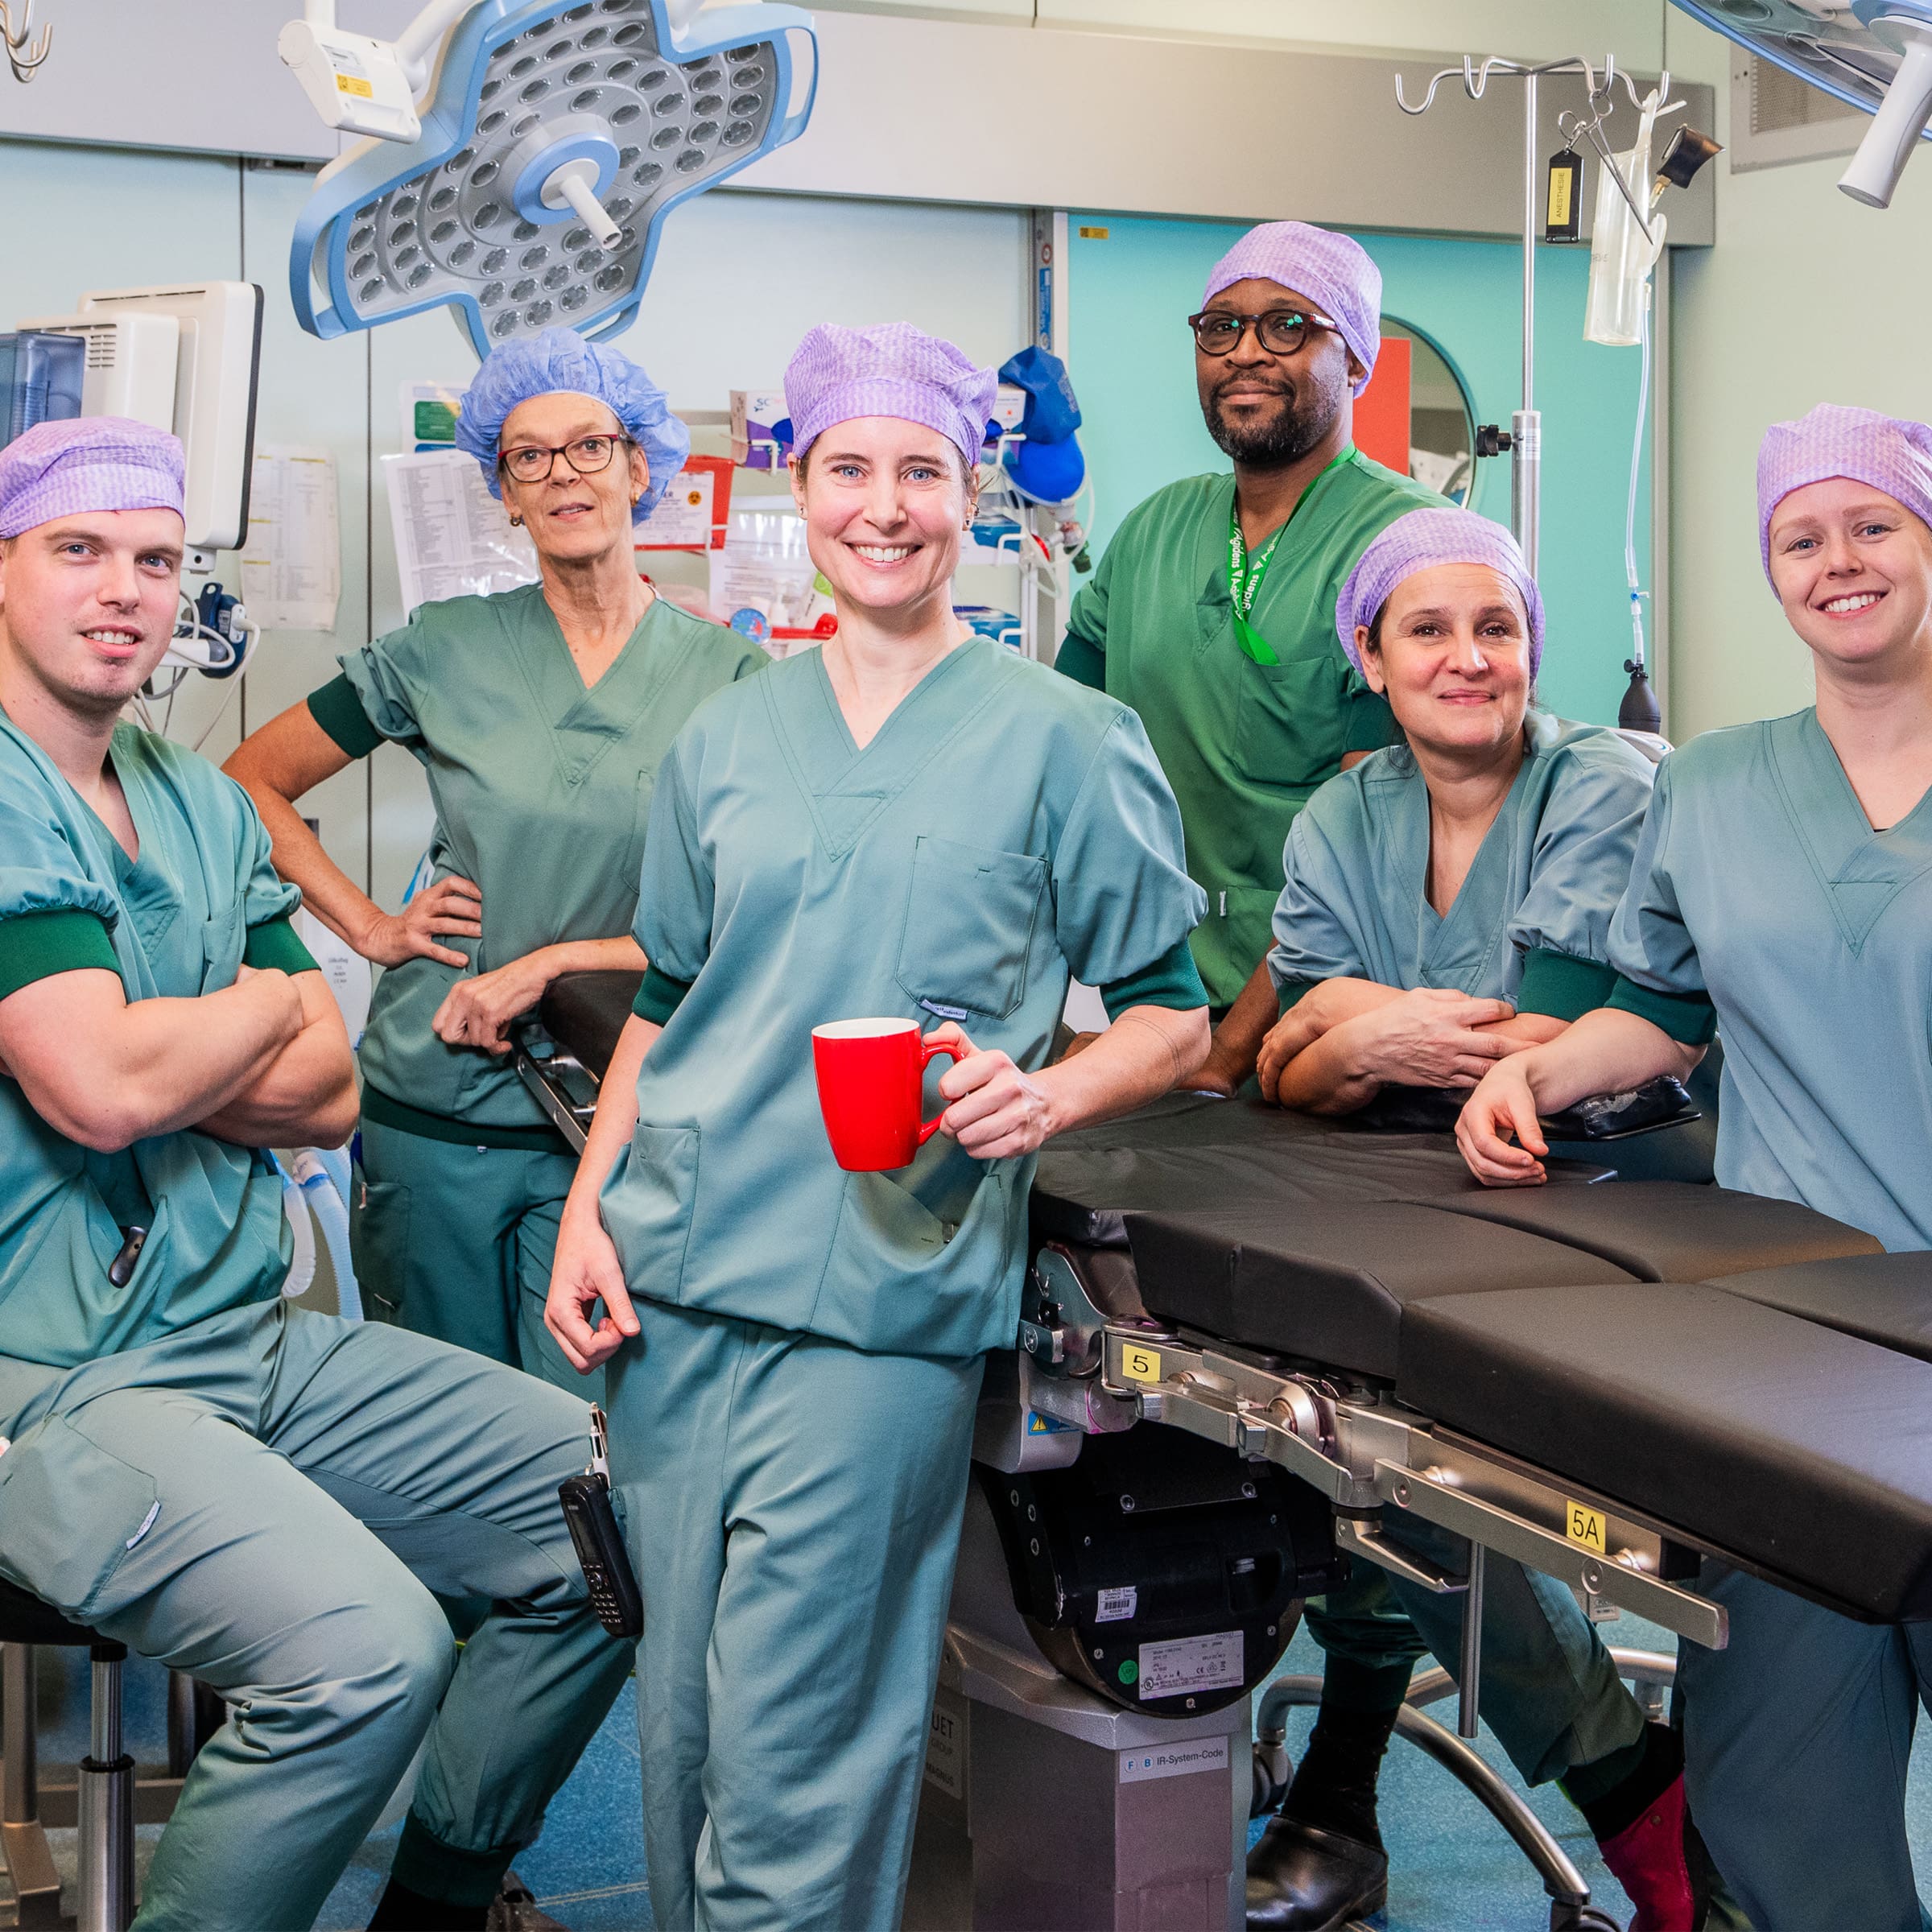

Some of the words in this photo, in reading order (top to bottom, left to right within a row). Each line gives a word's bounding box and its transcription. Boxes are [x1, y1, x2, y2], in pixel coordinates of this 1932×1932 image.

[1556, 172, 1565, 217] ANESTHESIE
[1229, 530, 1244, 568] Agidens
[1241, 574, 1260, 612] gidens
[1132, 1355, 1149, 1373] 5
[1572, 1509, 1599, 1546] 5A
[931, 1711, 954, 1739] UET
[1157, 1748, 1224, 1766] IR-System-Code
